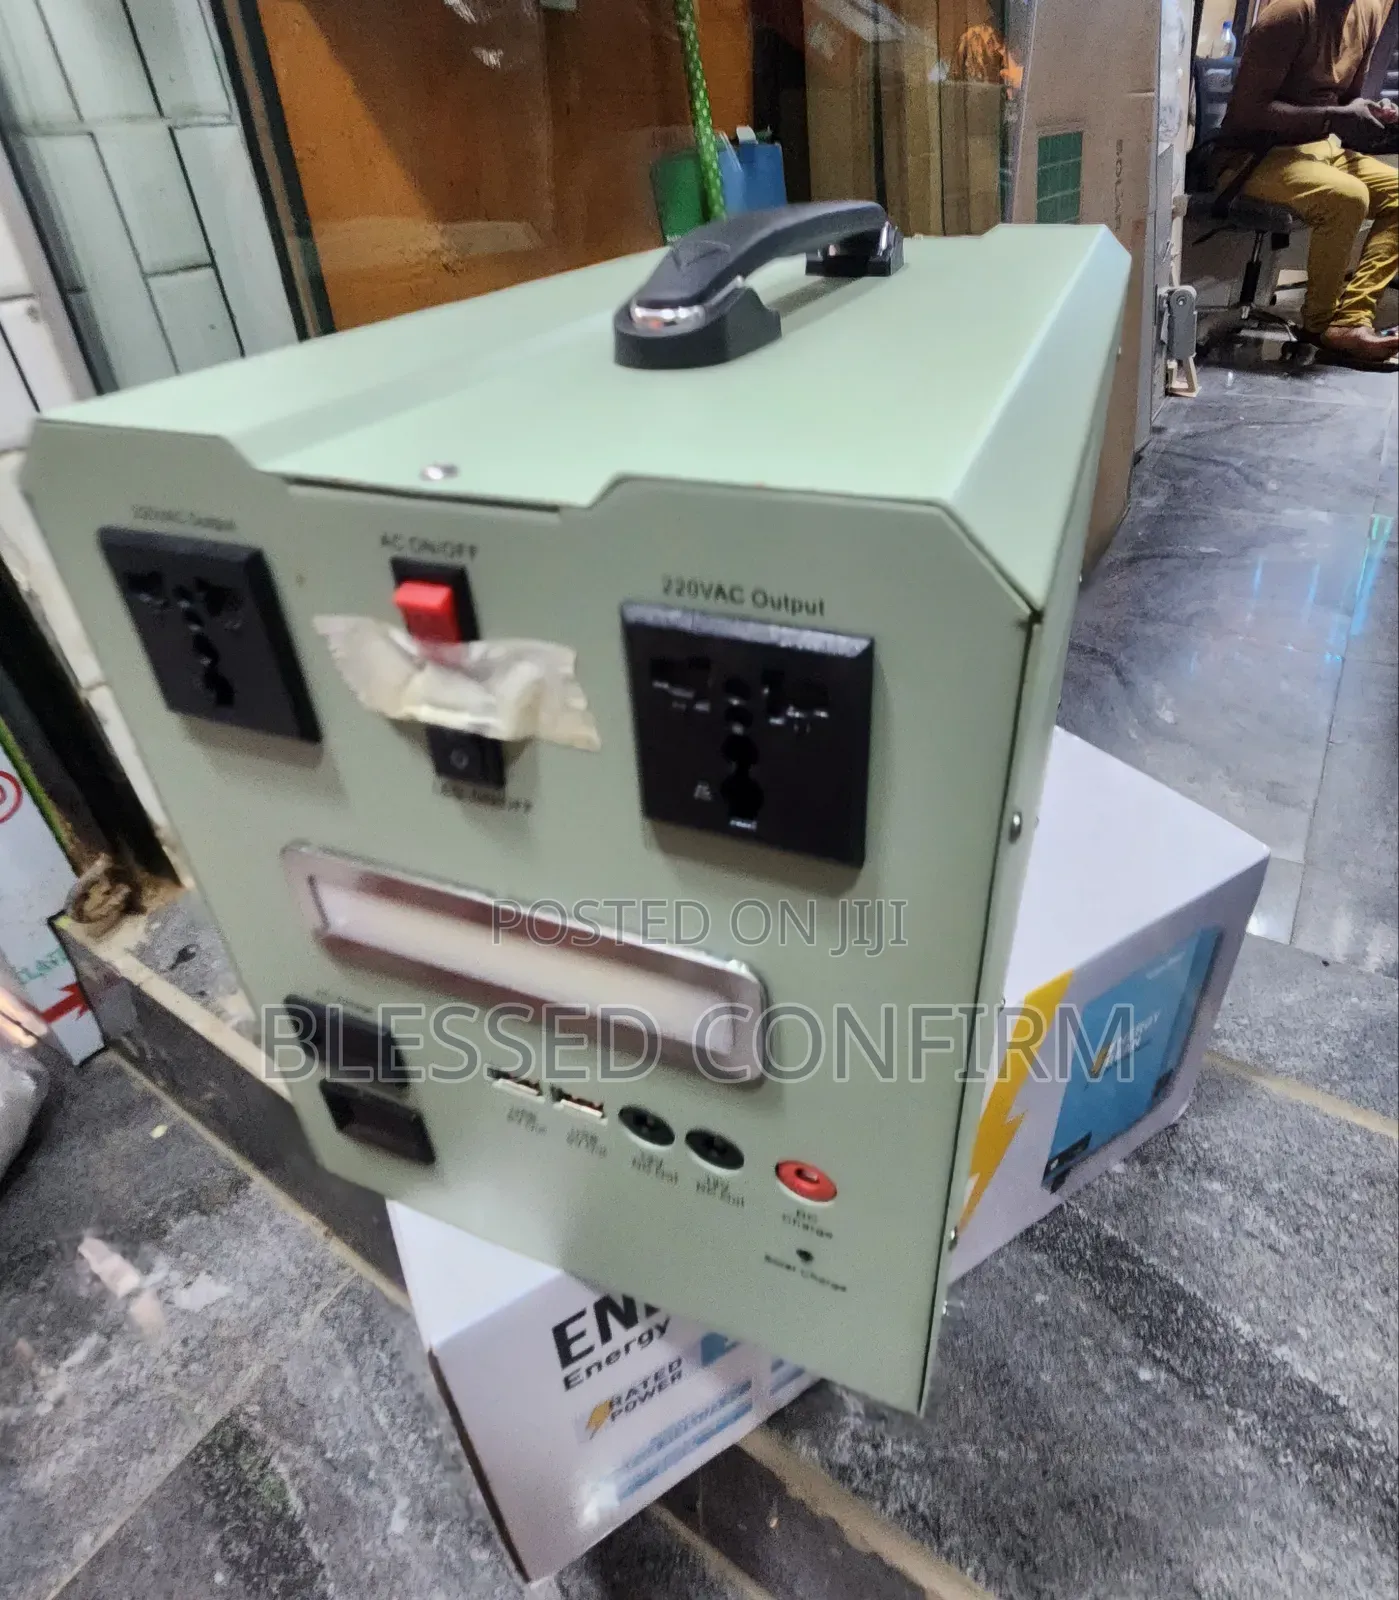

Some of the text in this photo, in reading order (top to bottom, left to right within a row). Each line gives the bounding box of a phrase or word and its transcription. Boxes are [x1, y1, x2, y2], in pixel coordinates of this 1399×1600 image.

[661, 573, 826, 617] 220VAC Output
[781, 1213, 834, 1240] Charge
[562, 1314, 671, 1392] Energy
[608, 1355, 683, 1408] RATED
[610, 1369, 683, 1422] POWER
